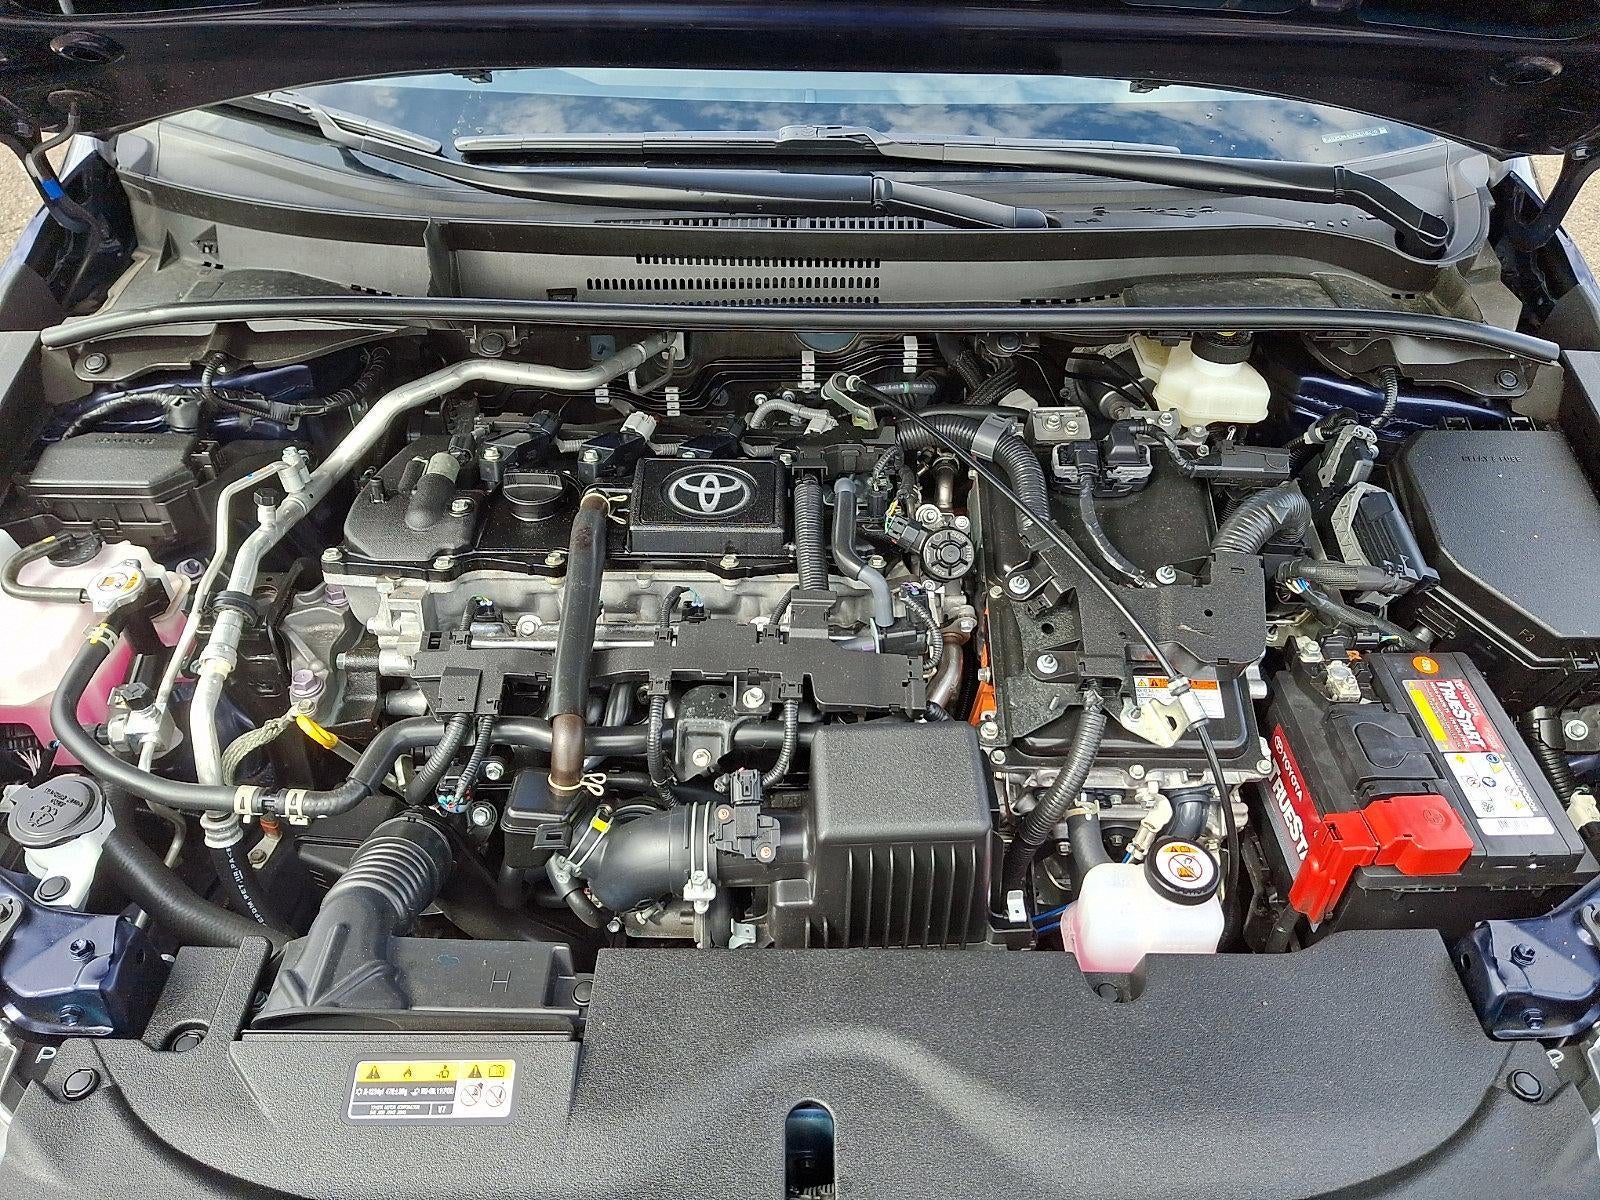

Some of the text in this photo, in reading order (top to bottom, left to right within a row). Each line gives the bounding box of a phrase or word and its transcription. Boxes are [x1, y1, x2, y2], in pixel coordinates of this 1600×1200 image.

[1436, 680, 1489, 751] TRUESTART
[1460, 687, 1481, 718] TOYOTA
[1281, 752, 1304, 803] TOYOTA
[489, 970, 512, 993] H
[35, 1046, 57, 1063] P
[1546, 1049, 1564, 1070] P
